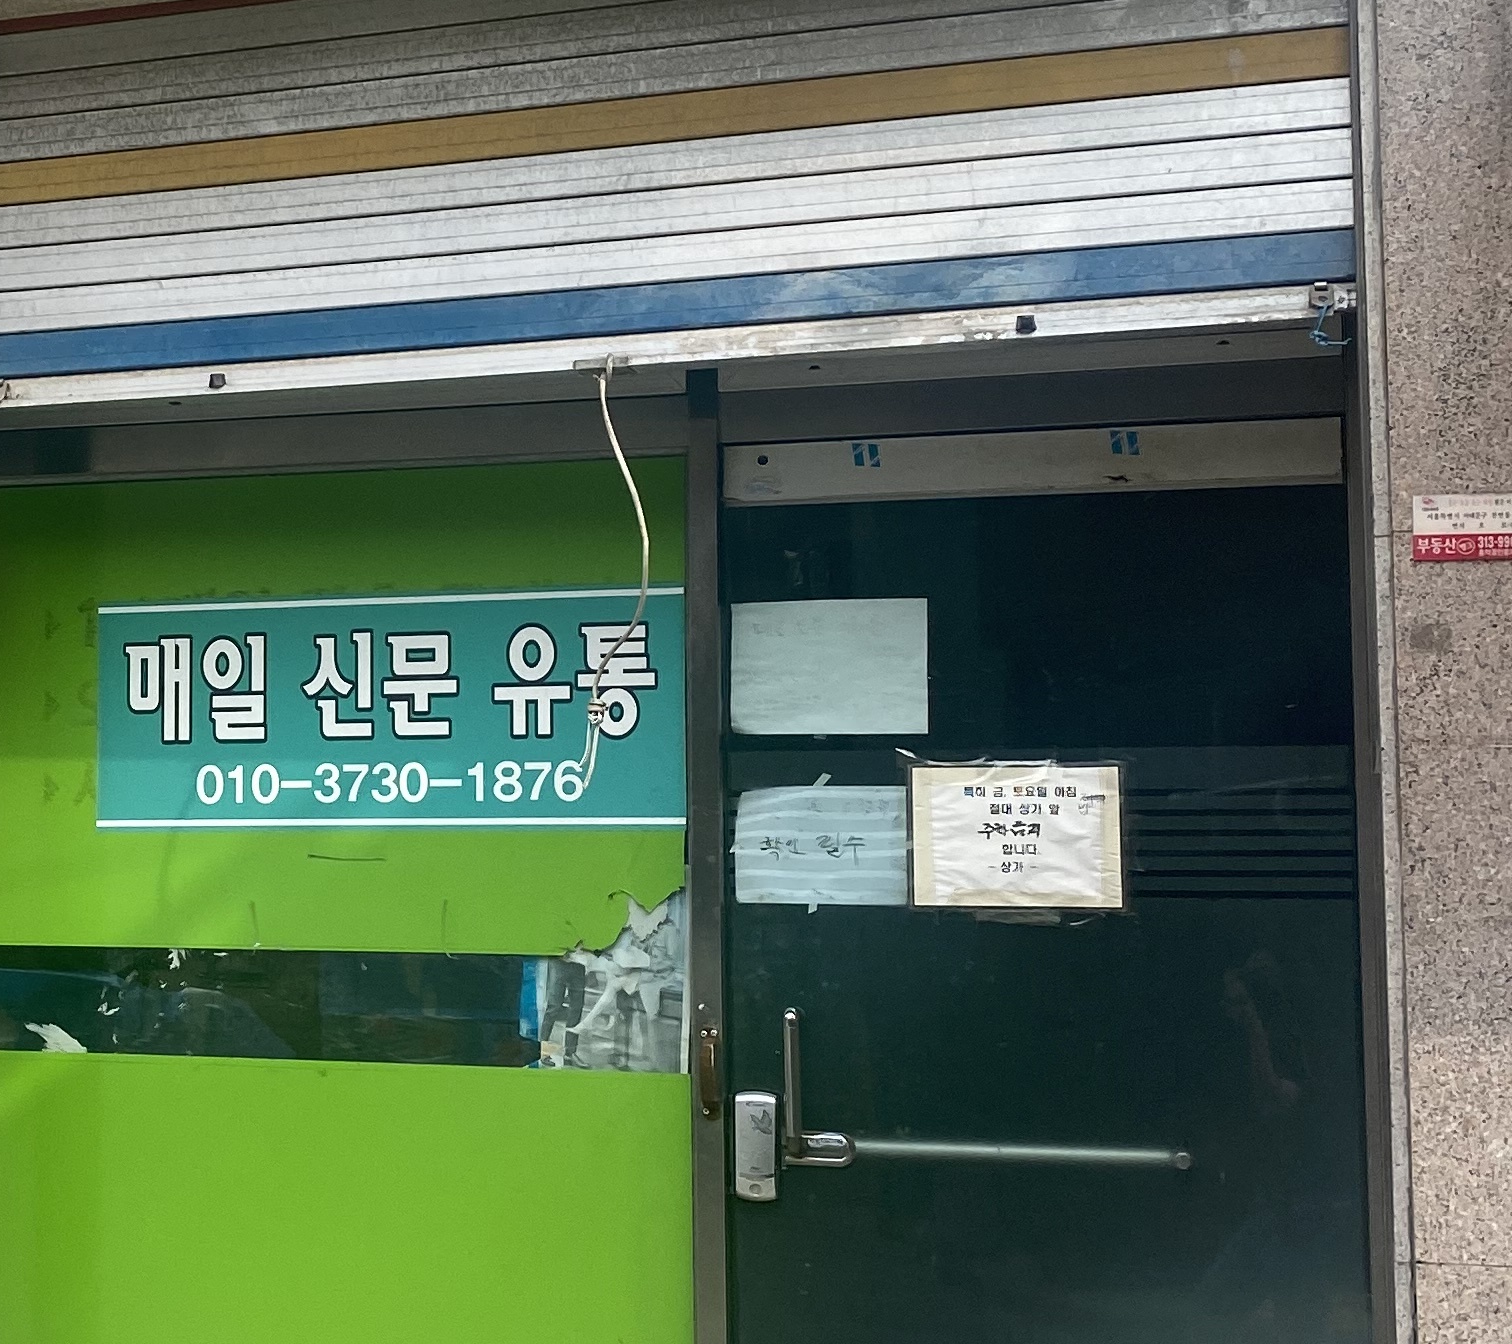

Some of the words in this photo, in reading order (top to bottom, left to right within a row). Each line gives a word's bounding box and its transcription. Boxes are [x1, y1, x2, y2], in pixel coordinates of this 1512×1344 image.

[1416, 537, 1457, 554] 부동산
[123, 632, 268, 744] 매일
[300, 628, 458, 741] 신문
[491, 622, 658, 739] 유통
[195, 760, 585, 805] 010-3730-1876
[963, 786, 986, 798] 특히
[1013, 786, 1047, 798] 토요일
[1054, 786, 1077, 798] 아침
[989, 803, 1012, 815] 절대
